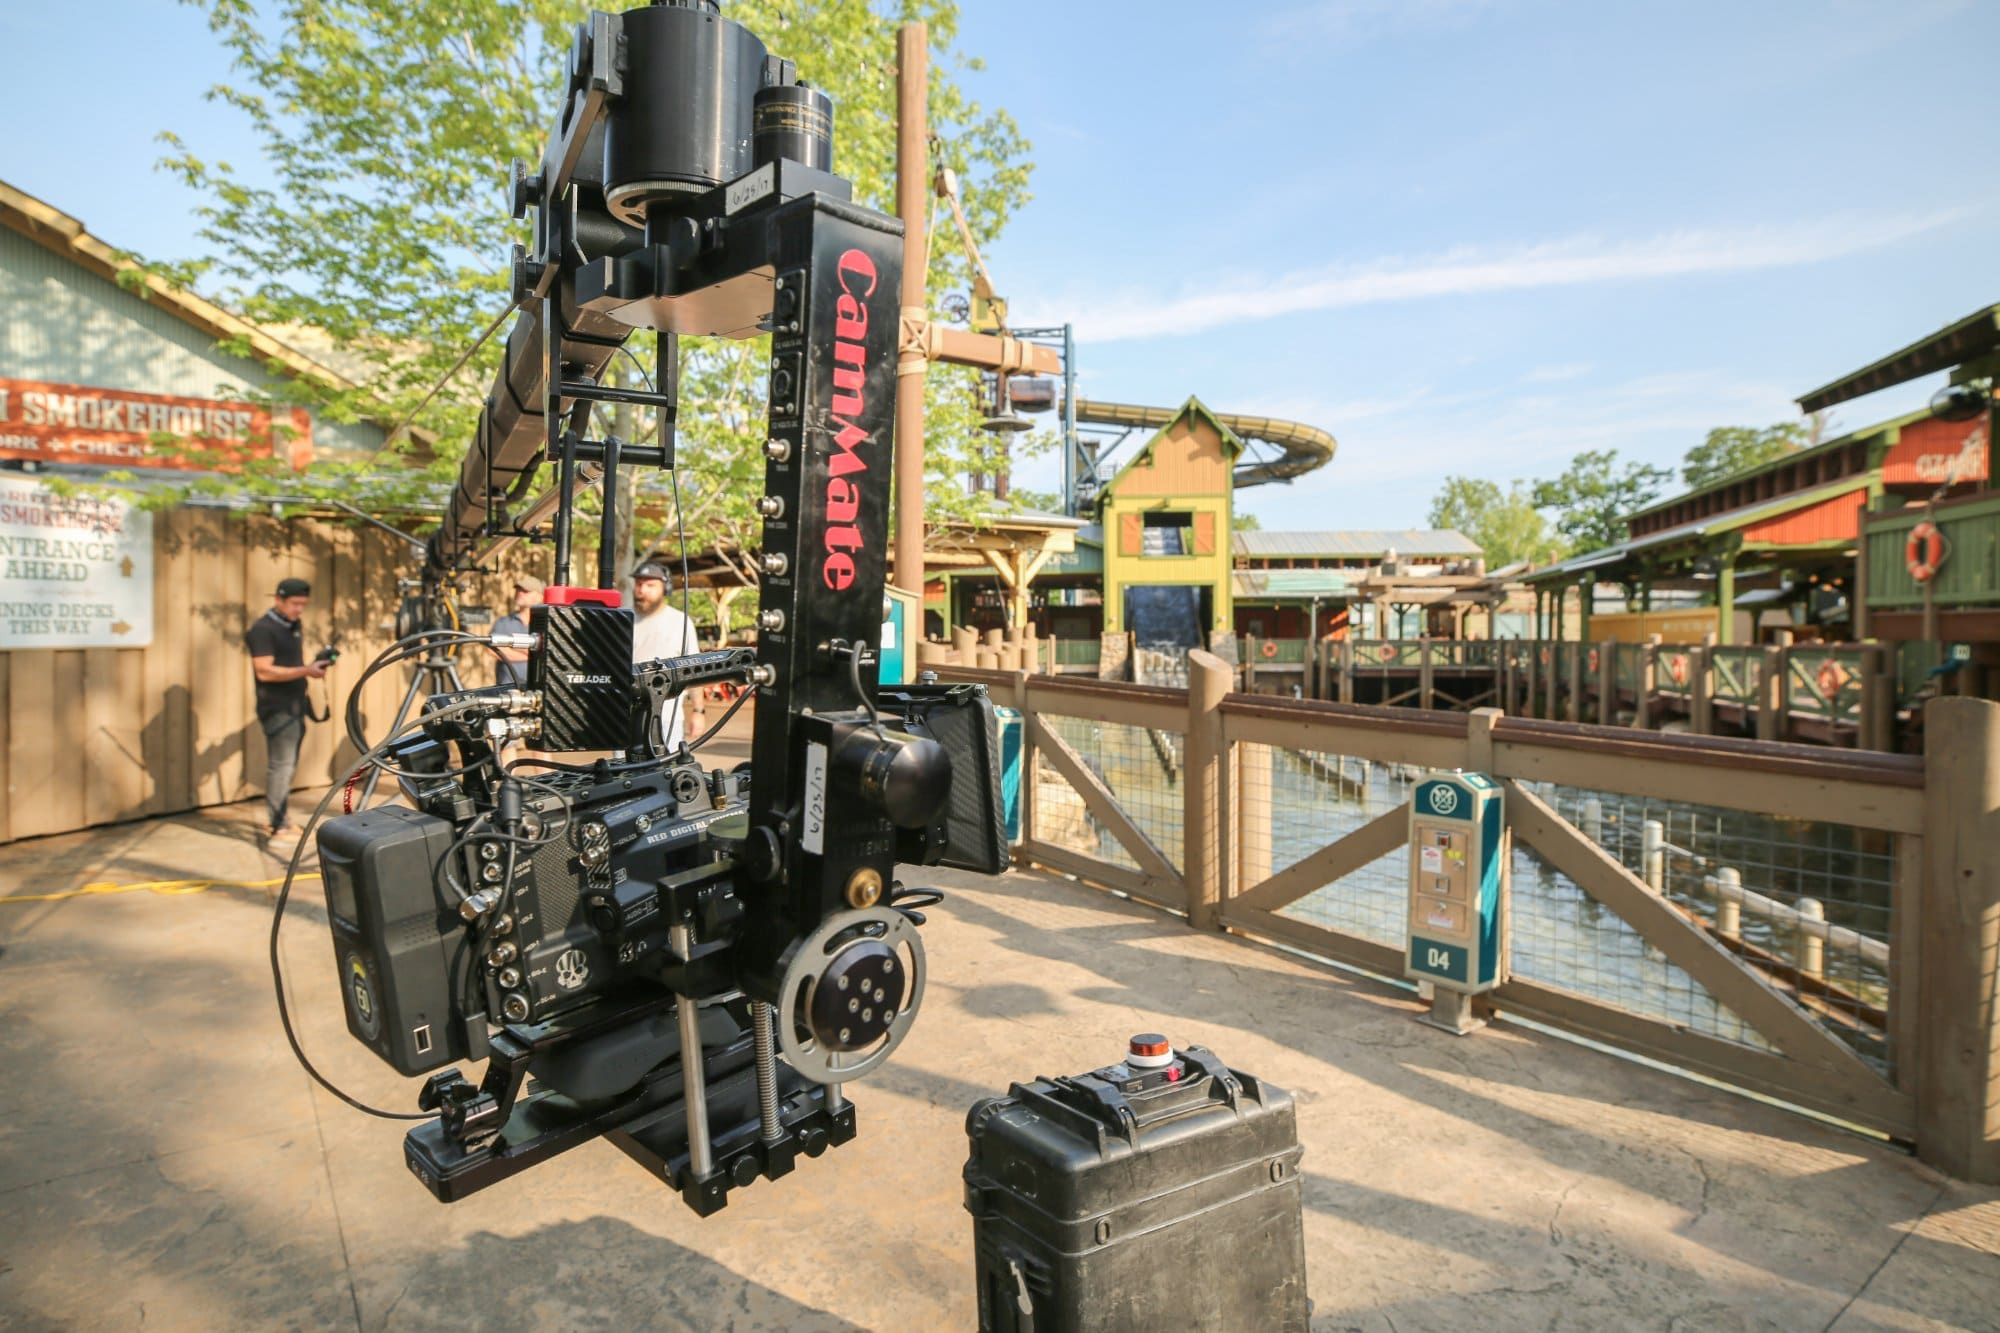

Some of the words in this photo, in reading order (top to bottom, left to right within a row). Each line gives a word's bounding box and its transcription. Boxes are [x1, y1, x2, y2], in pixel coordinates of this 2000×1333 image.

[22, 391, 252, 442] SMOKEHOUSE
[823, 249, 877, 591] CanMate
[4, 559, 89, 582] AHEAD
[58, 603, 115, 619] DECKS
[8, 619, 50, 635] THIS
[53, 620, 92, 635] WAY
[566, 674, 612, 684] TERADEK
[646, 831, 668, 844] RED
[669, 819, 708, 838] DIGITAL
[1427, 947, 1450, 971] 04
